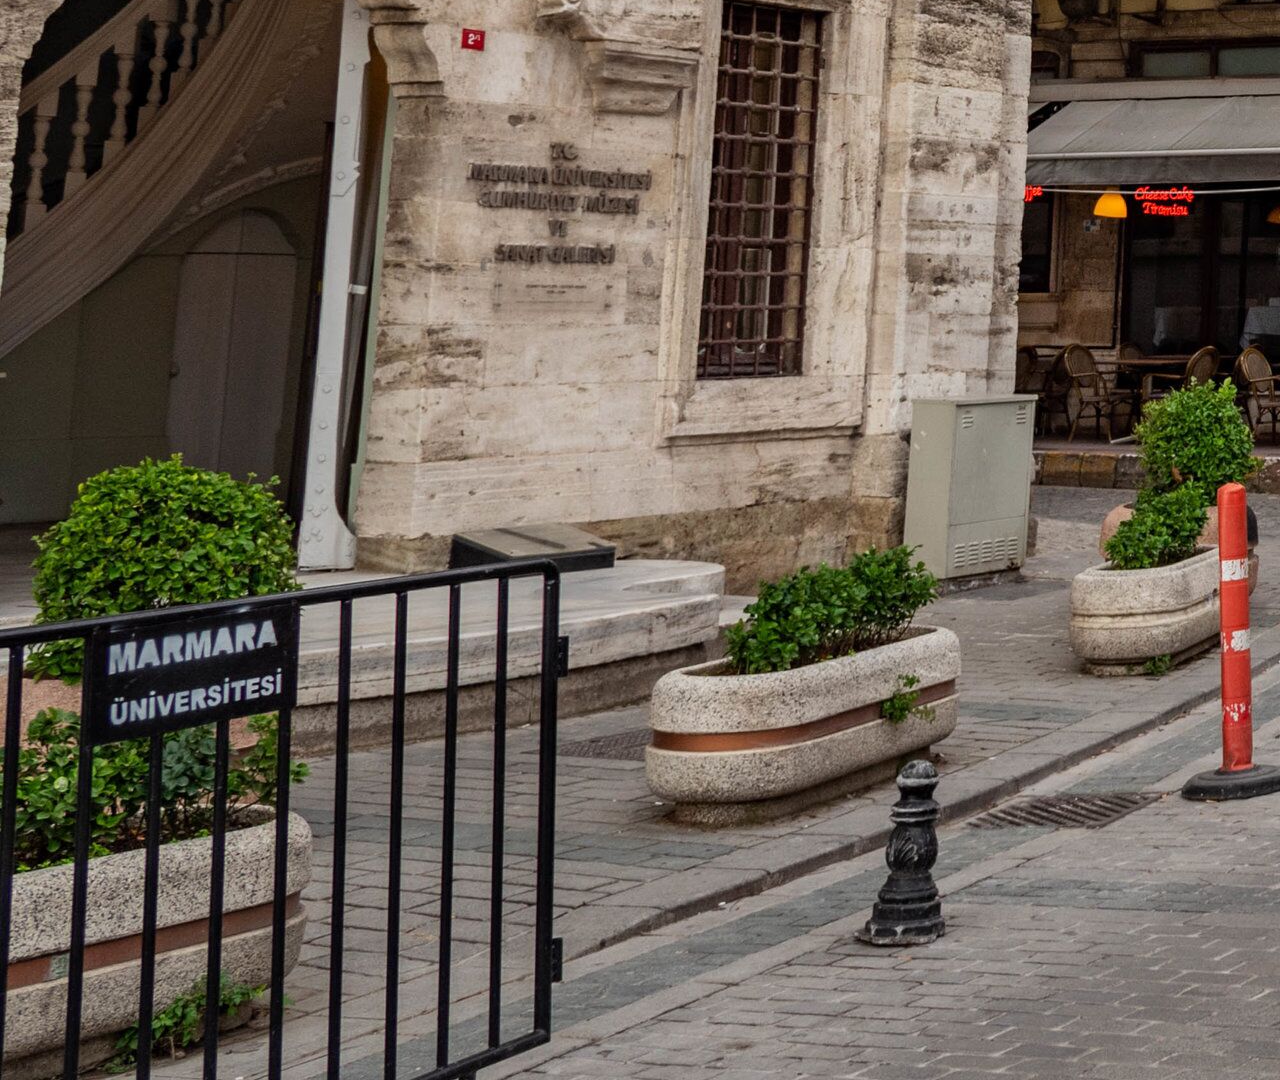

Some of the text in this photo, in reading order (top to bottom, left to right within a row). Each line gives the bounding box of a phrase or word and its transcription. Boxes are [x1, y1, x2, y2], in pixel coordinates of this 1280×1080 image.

[1024, 185, 1043, 203] ffee
[108, 620, 278, 675] MARMARA
[110, 668, 282, 726] ÜNİVERSİTESİ
